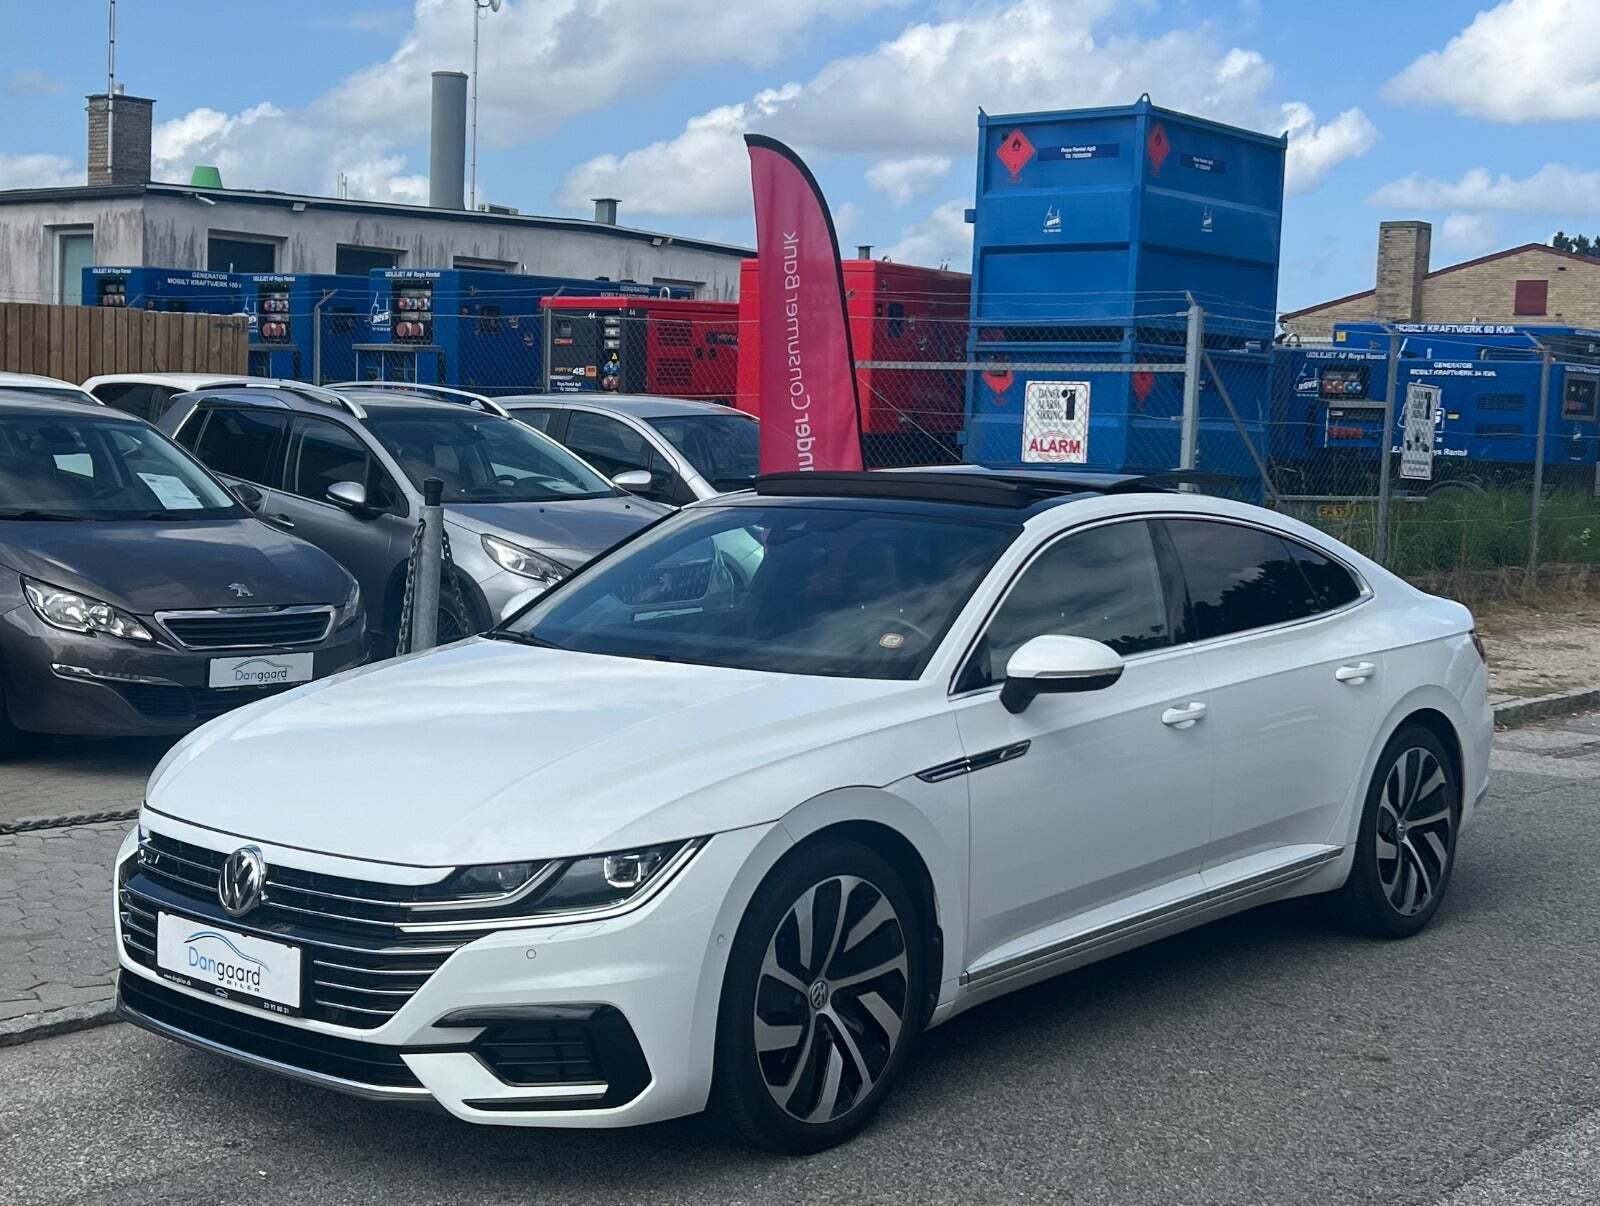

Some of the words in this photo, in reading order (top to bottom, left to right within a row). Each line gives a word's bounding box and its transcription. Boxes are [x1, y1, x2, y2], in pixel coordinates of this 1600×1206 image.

[1029, 438, 1080, 454] ALARM
[235, 668, 288, 682] Dangaard
[189, 945, 261, 986] Dangaard
